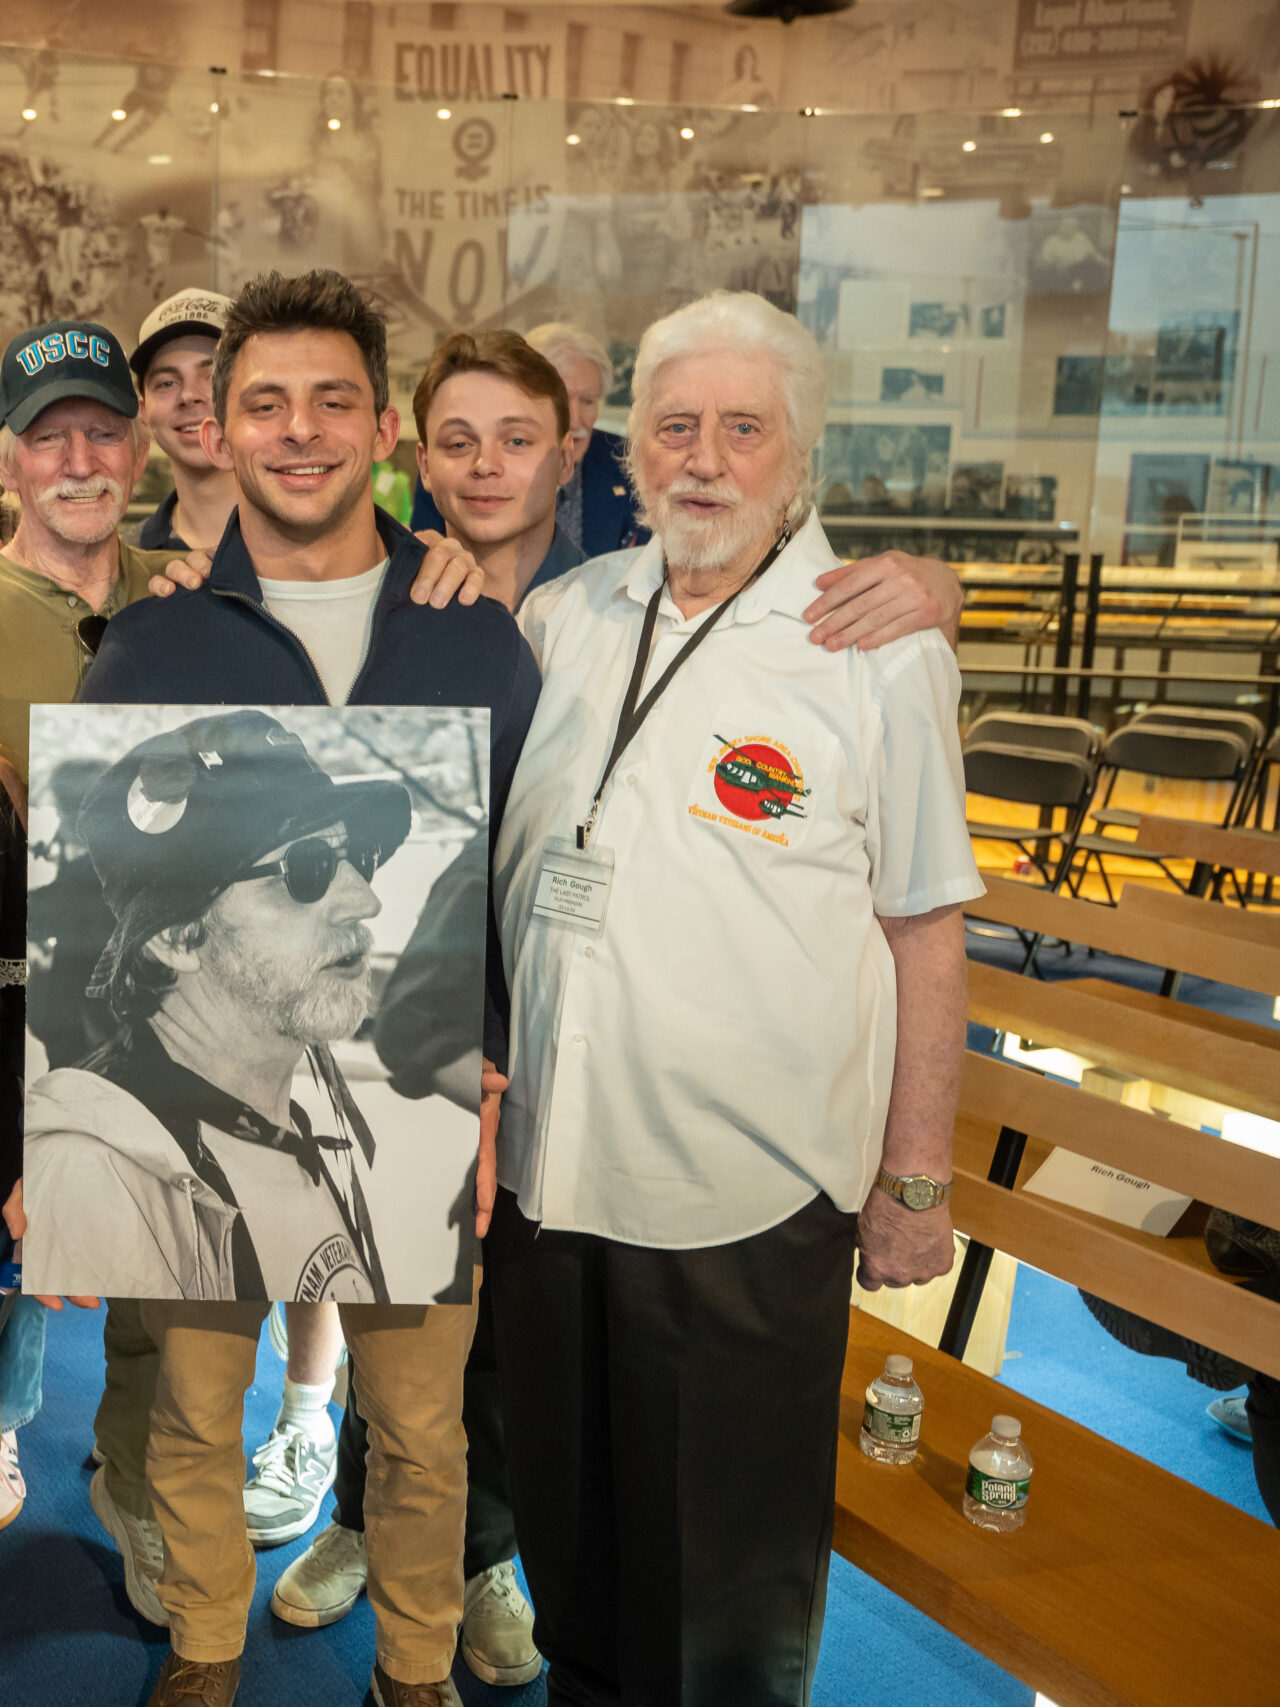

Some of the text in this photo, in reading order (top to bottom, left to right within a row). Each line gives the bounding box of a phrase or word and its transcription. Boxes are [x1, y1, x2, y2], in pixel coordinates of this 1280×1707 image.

[394, 42, 552, 102] EQUALITY
[394, 184, 552, 220] THE TIME IS
[394, 224, 550, 313] NOW
[16, 330, 110, 376] USCC
[552, 876, 593, 893] Rich Gough
[1091, 1165, 1151, 1190] Rich Gough
[982, 1480, 1016, 1492] Poland
[982, 1490, 1017, 1502] Spring
